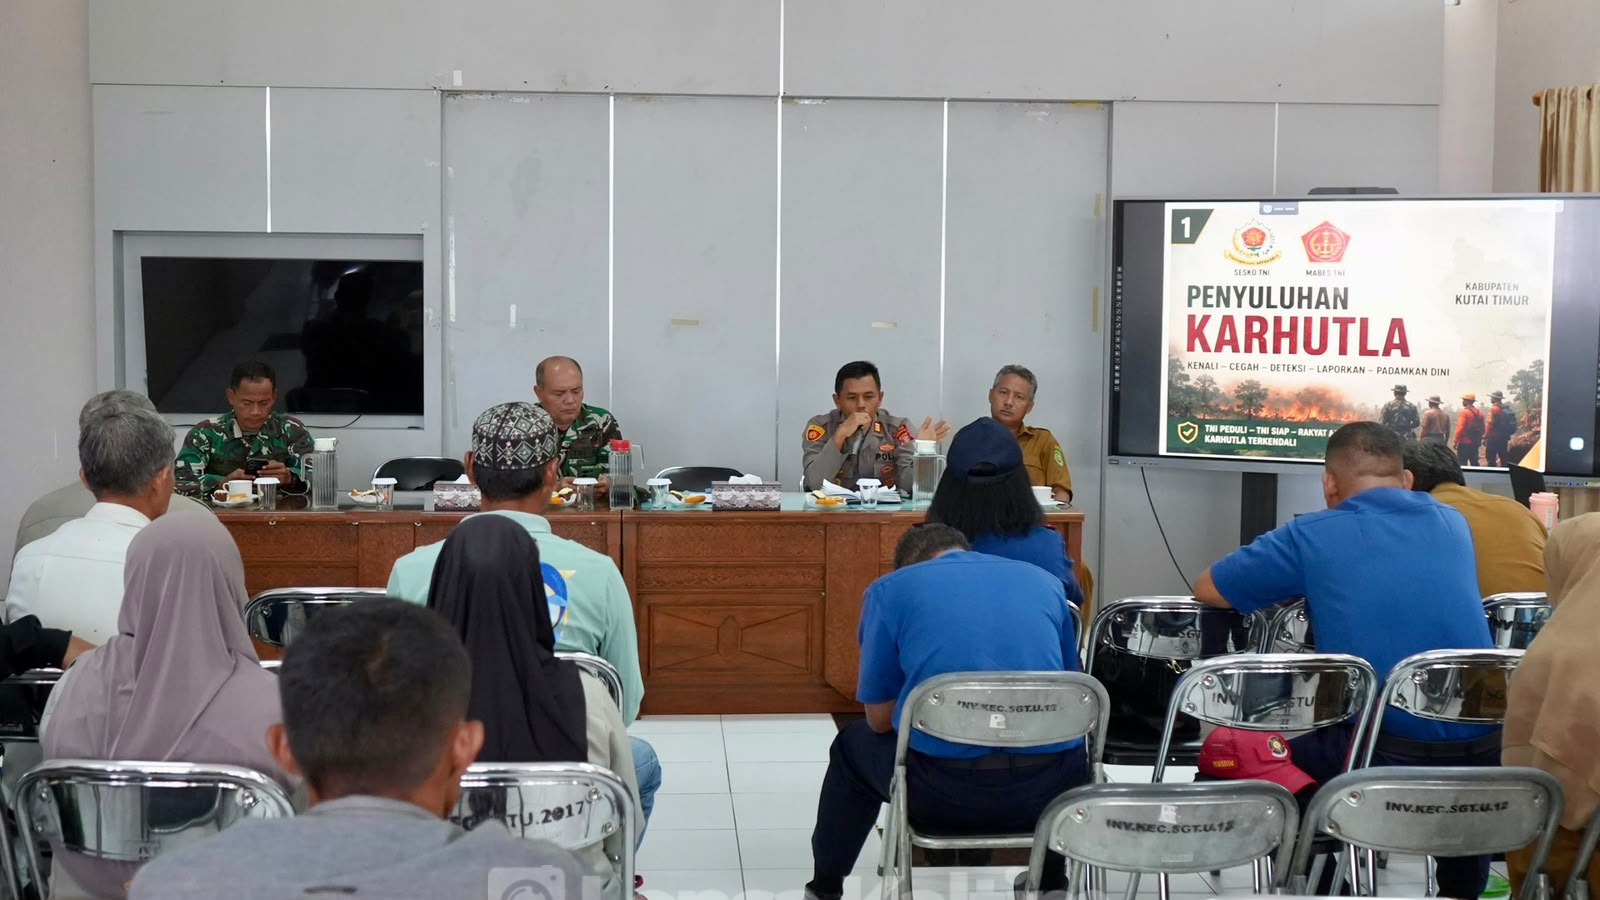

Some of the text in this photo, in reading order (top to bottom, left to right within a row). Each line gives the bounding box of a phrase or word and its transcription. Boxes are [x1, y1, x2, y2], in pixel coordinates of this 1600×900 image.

[1181, 217, 1191, 238] 1
[1465, 282, 1519, 291] KABUPATEN
[1187, 285, 1349, 310] PENYULUHAN
[1455, 294, 1529, 306] KUTAI TIMUR
[1186, 314, 1411, 358] KARHUTLA
[1187, 361, 1219, 370] KENALI
[1229, 362, 1259, 371] CEGAH
[1270, 363, 1306, 372] DETEKSI
[1316, 364, 1365, 374] LAPORKAN
[1376, 366, 1428, 376] PADAMKAN
[1430, 367, 1450, 377] DINI
[1204, 424, 1218, 433] TNI
[1220, 425, 1248, 434] PEDULI
[1256, 426, 1269, 435] TNI
[1271, 427, 1290, 436] SIAP
[1298, 428, 1328, 437] RAKYAT
[1204, 435, 1297, 446] KARHUTLA TERKENDALI
